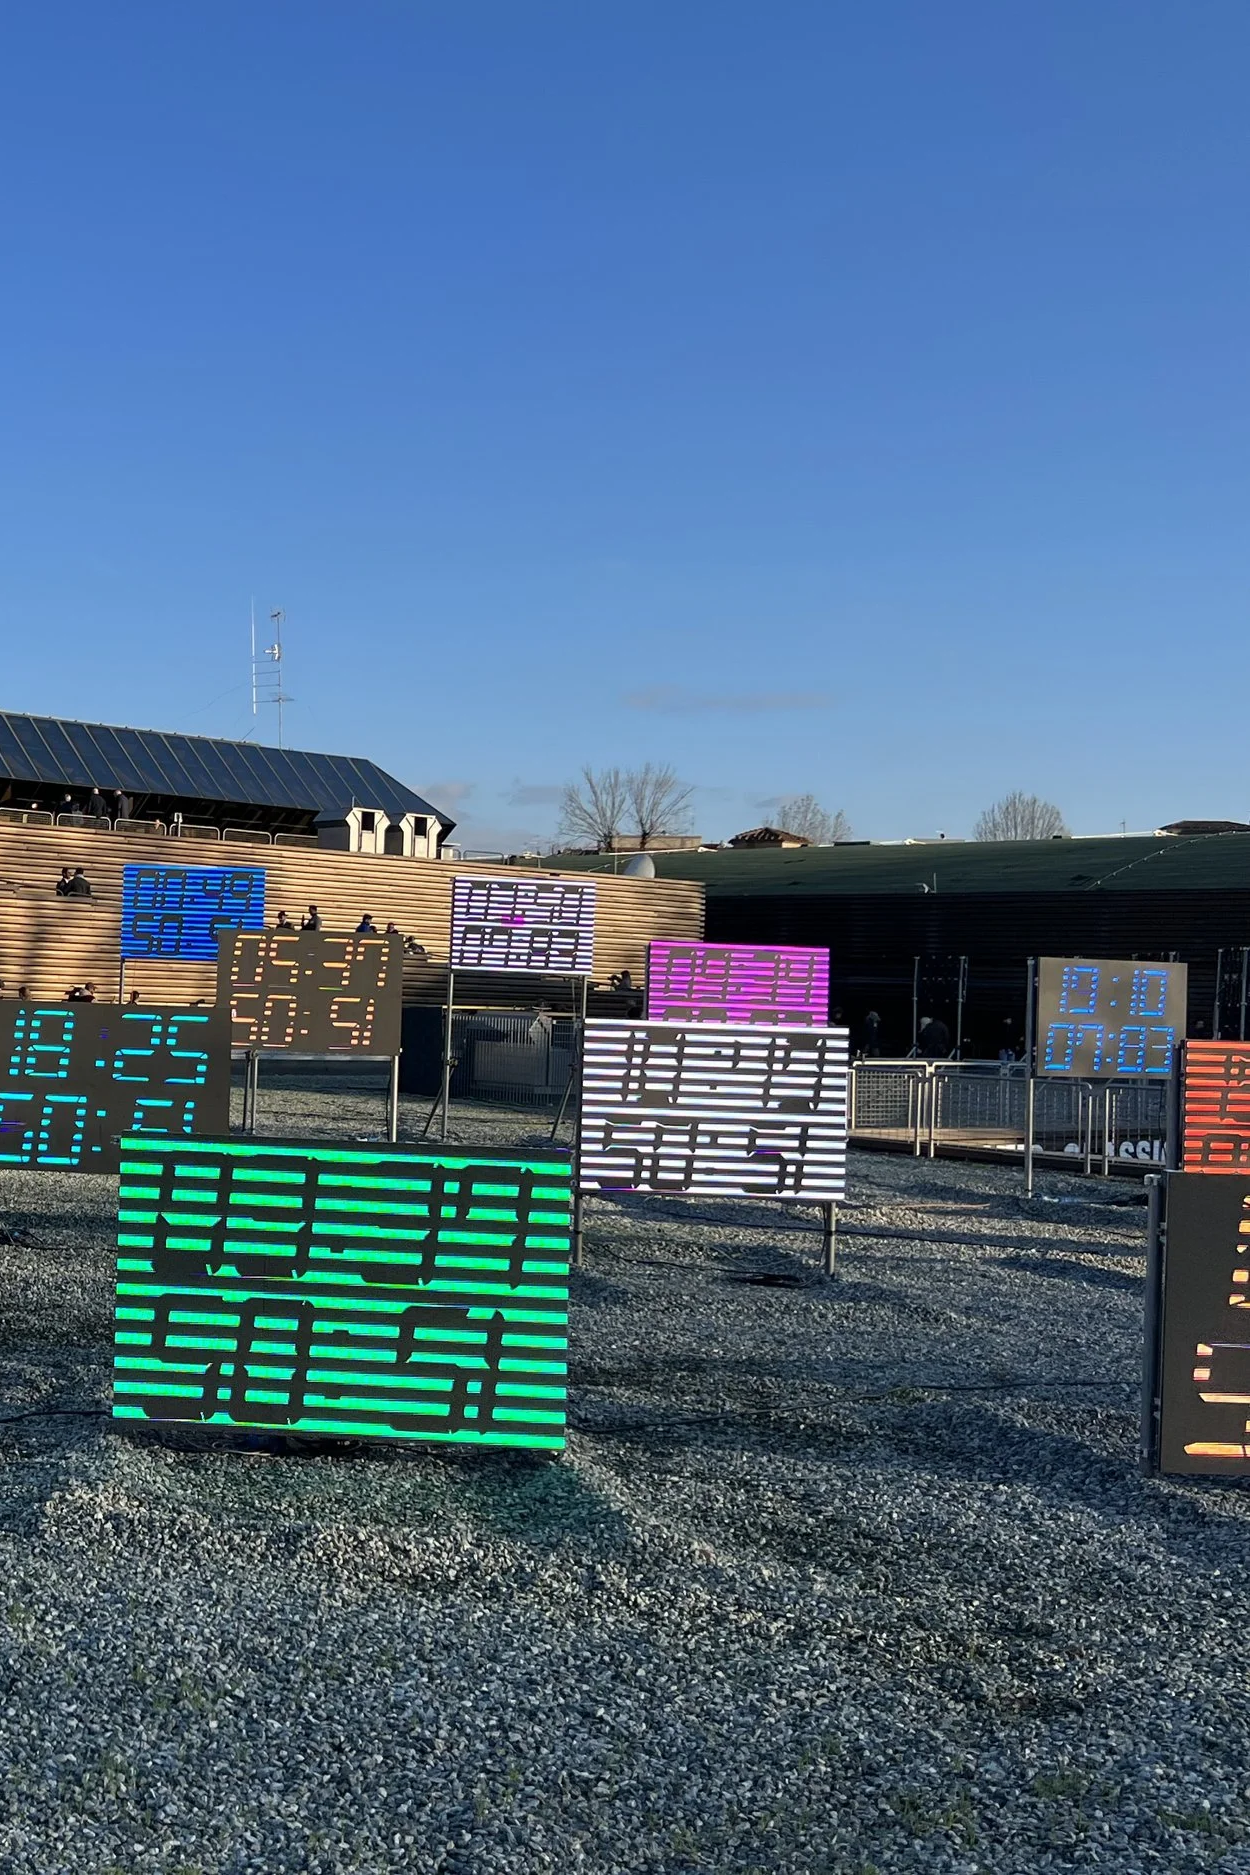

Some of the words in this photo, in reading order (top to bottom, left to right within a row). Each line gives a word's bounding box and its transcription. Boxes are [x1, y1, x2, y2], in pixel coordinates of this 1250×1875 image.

[133, 870, 254, 911] 00:49
[230, 934, 390, 990] 05:37
[1059, 966, 1167, 1017] 19:10
[8, 1009, 209, 1084] 18:25
[229, 993, 375, 1050] 50:51
[1044, 1022, 1174, 1073] 07:83
